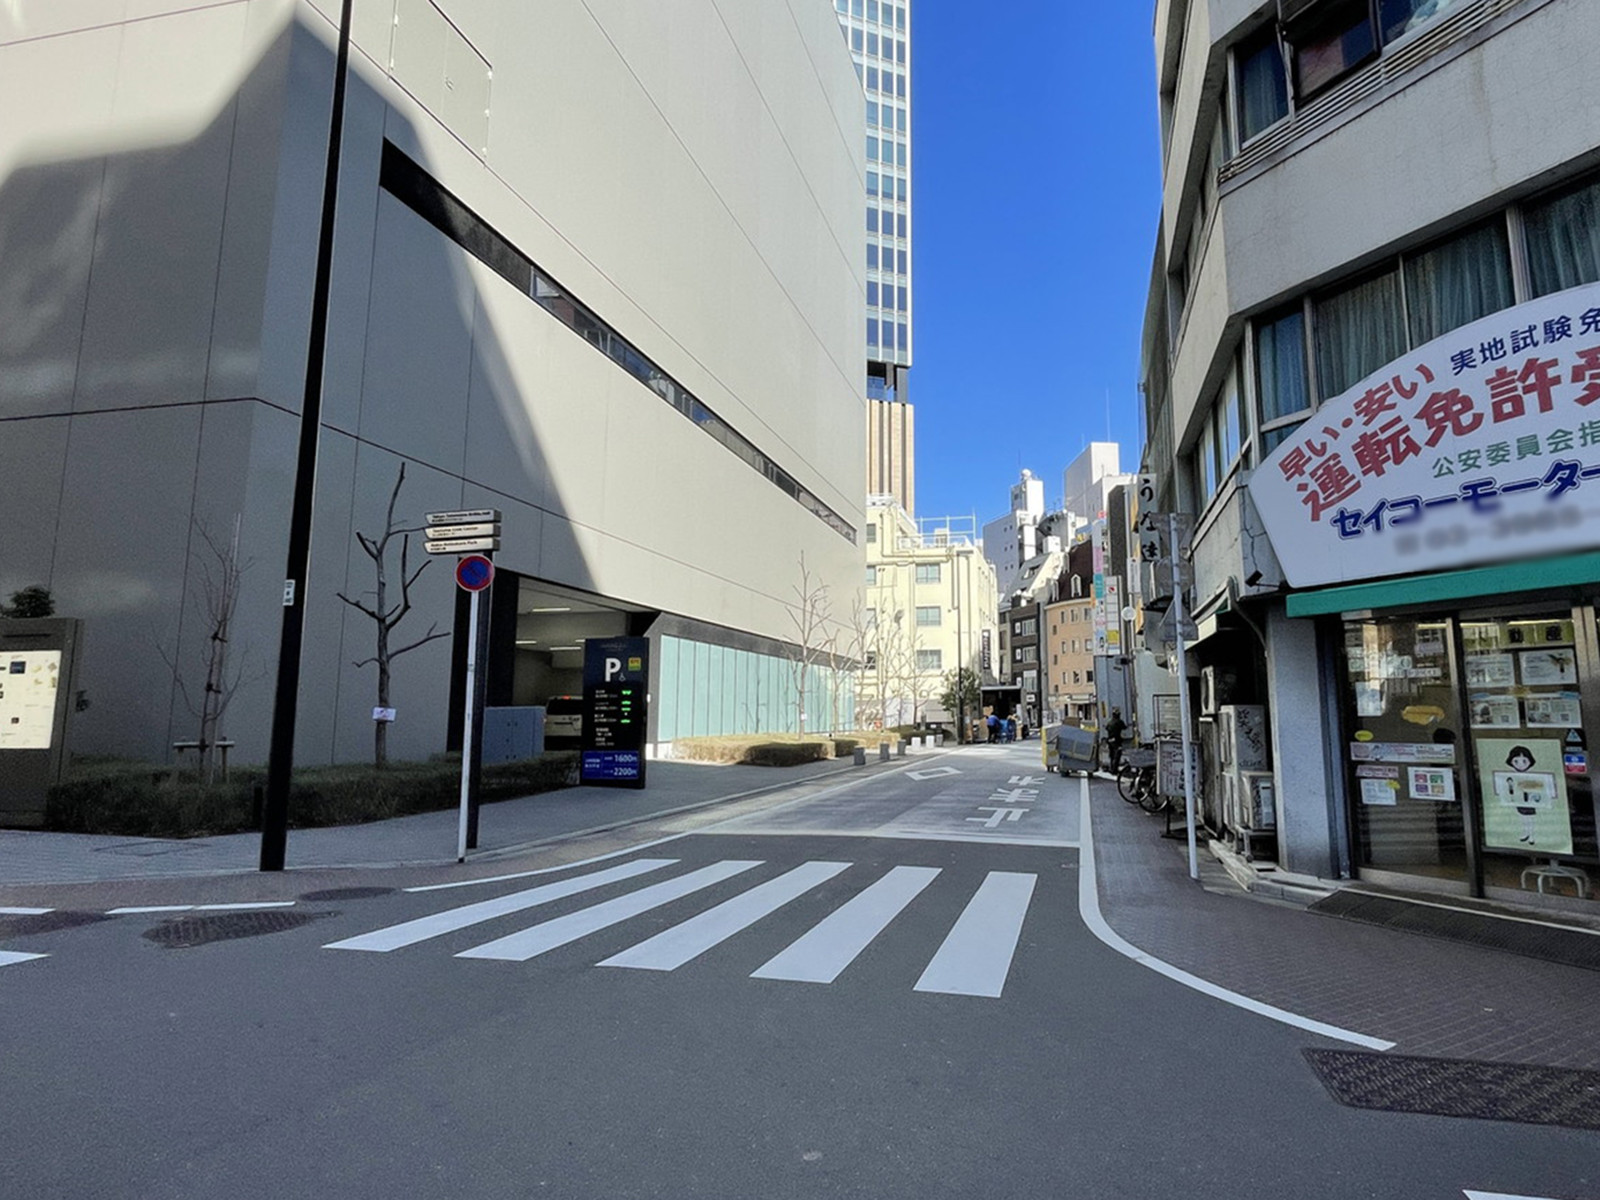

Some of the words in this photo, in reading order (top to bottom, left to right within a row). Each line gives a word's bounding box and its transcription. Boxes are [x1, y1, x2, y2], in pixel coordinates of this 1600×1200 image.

[1450, 307, 1600, 376] 実地試験免
[1278, 363, 1435, 482] 早い・安い
[1432, 420, 1600, 478] 公安委員会指
[605, 658, 621, 682] P
[965, 775, 1047, 828] 止まれ
